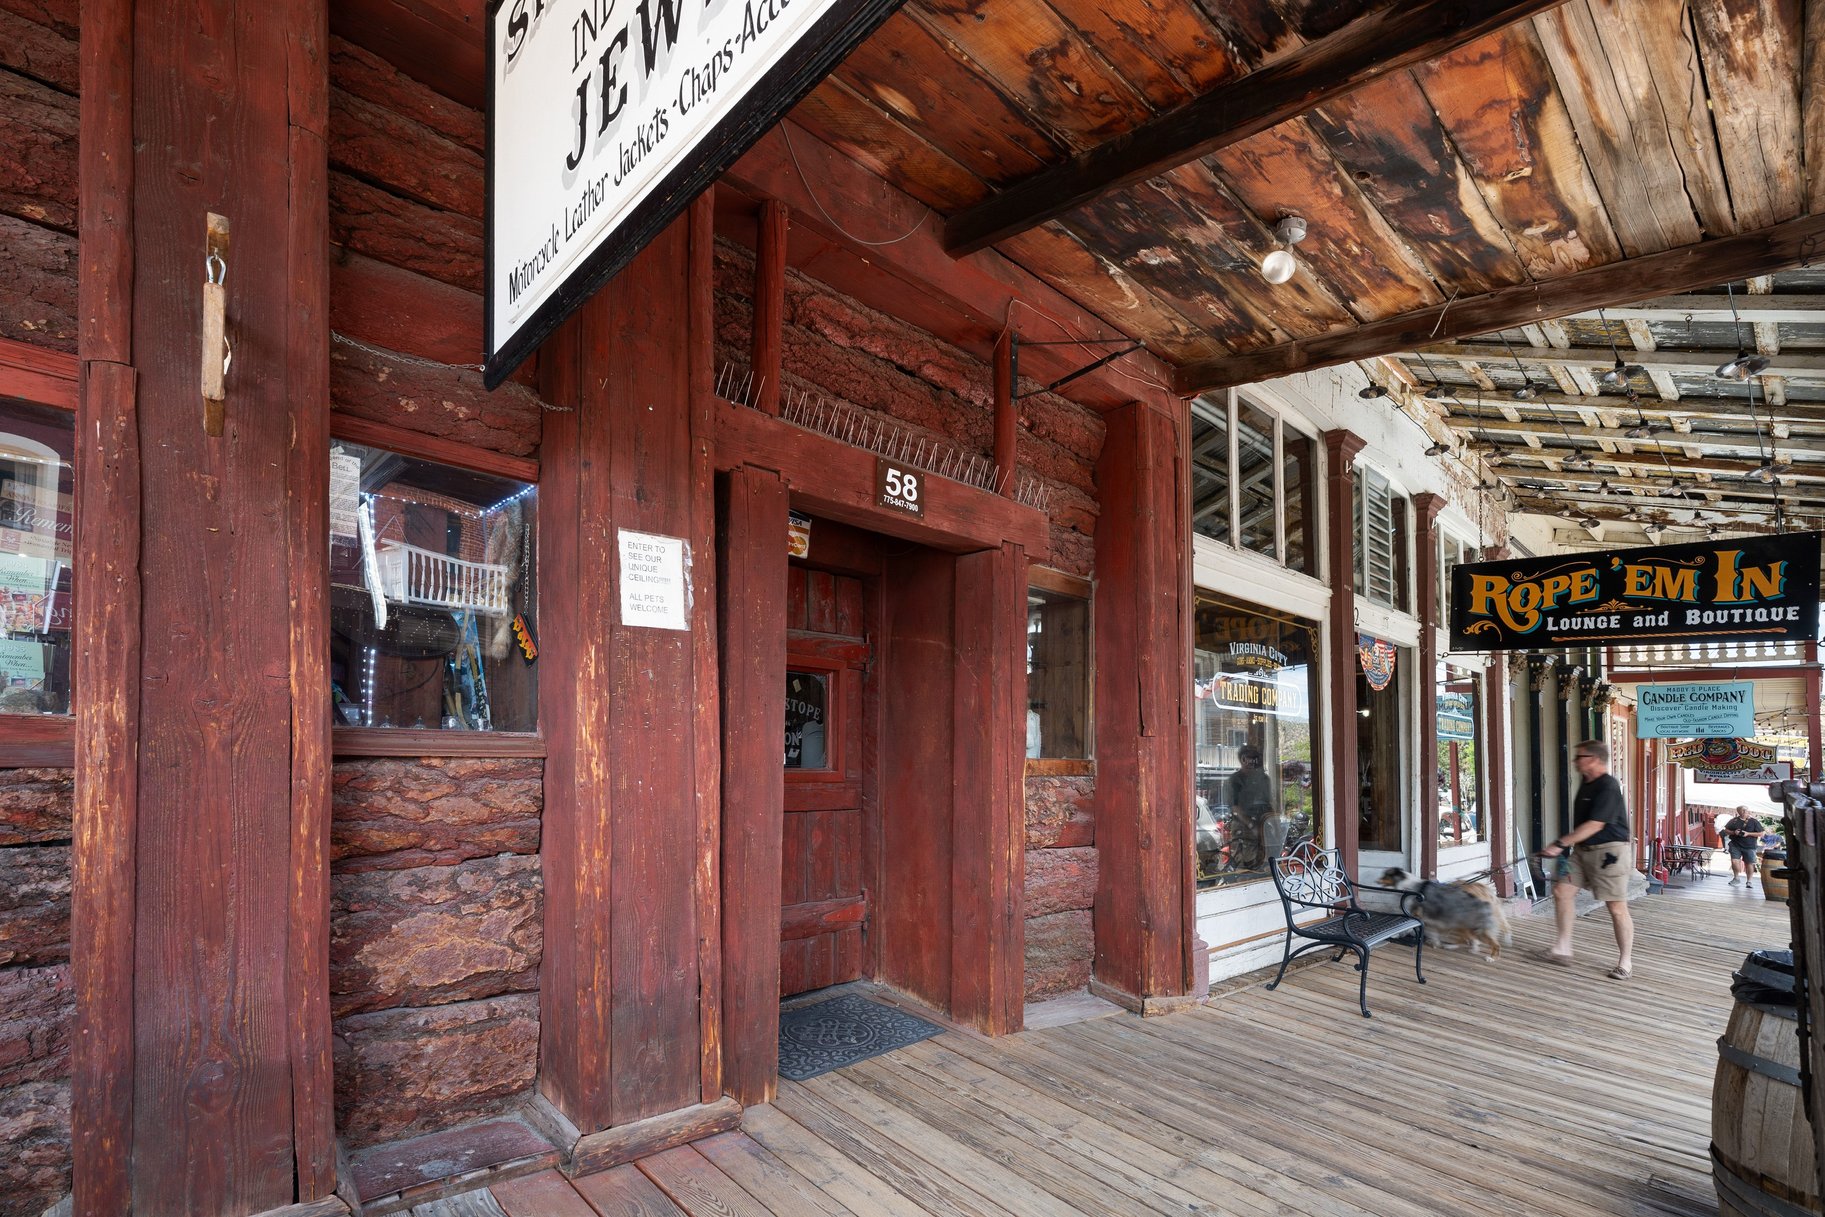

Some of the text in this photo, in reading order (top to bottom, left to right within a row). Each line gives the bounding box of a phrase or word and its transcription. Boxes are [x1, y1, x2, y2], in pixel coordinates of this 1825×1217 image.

[566, 0, 712, 171] JEW
[509, 223, 560, 305] Motorcycle
[565, 173, 608, 243] Leather
[614, 107, 669, 186] Jackets
[741, 0, 791, 54] Acc
[885, 468, 917, 501] 58
[883, 494, 919, 512] 775-847-7900
[627, 541, 666, 554] ENTER TO
[628, 552, 662, 563] SEE OUR
[628, 563, 658, 573] UNIQUE
[629, 593, 664, 603] ALL PETS
[1469, 568, 1599, 634] ROPE
[1712, 550, 1787, 605] IN
[629, 603, 669, 614] WELCOME
[1546, 605, 1800, 631] LOUNGE and BOUTIQUE
[1229, 642, 1267, 657] VIRGINIA
[1268, 646, 1288, 666] CITY
[1220, 680, 1298, 709] TRADING COMPANY
[1643, 690, 1746, 705] CANDLE COMPANY
[1671, 742, 1704, 758] RED
[1738, 743, 1774, 760] DOG
